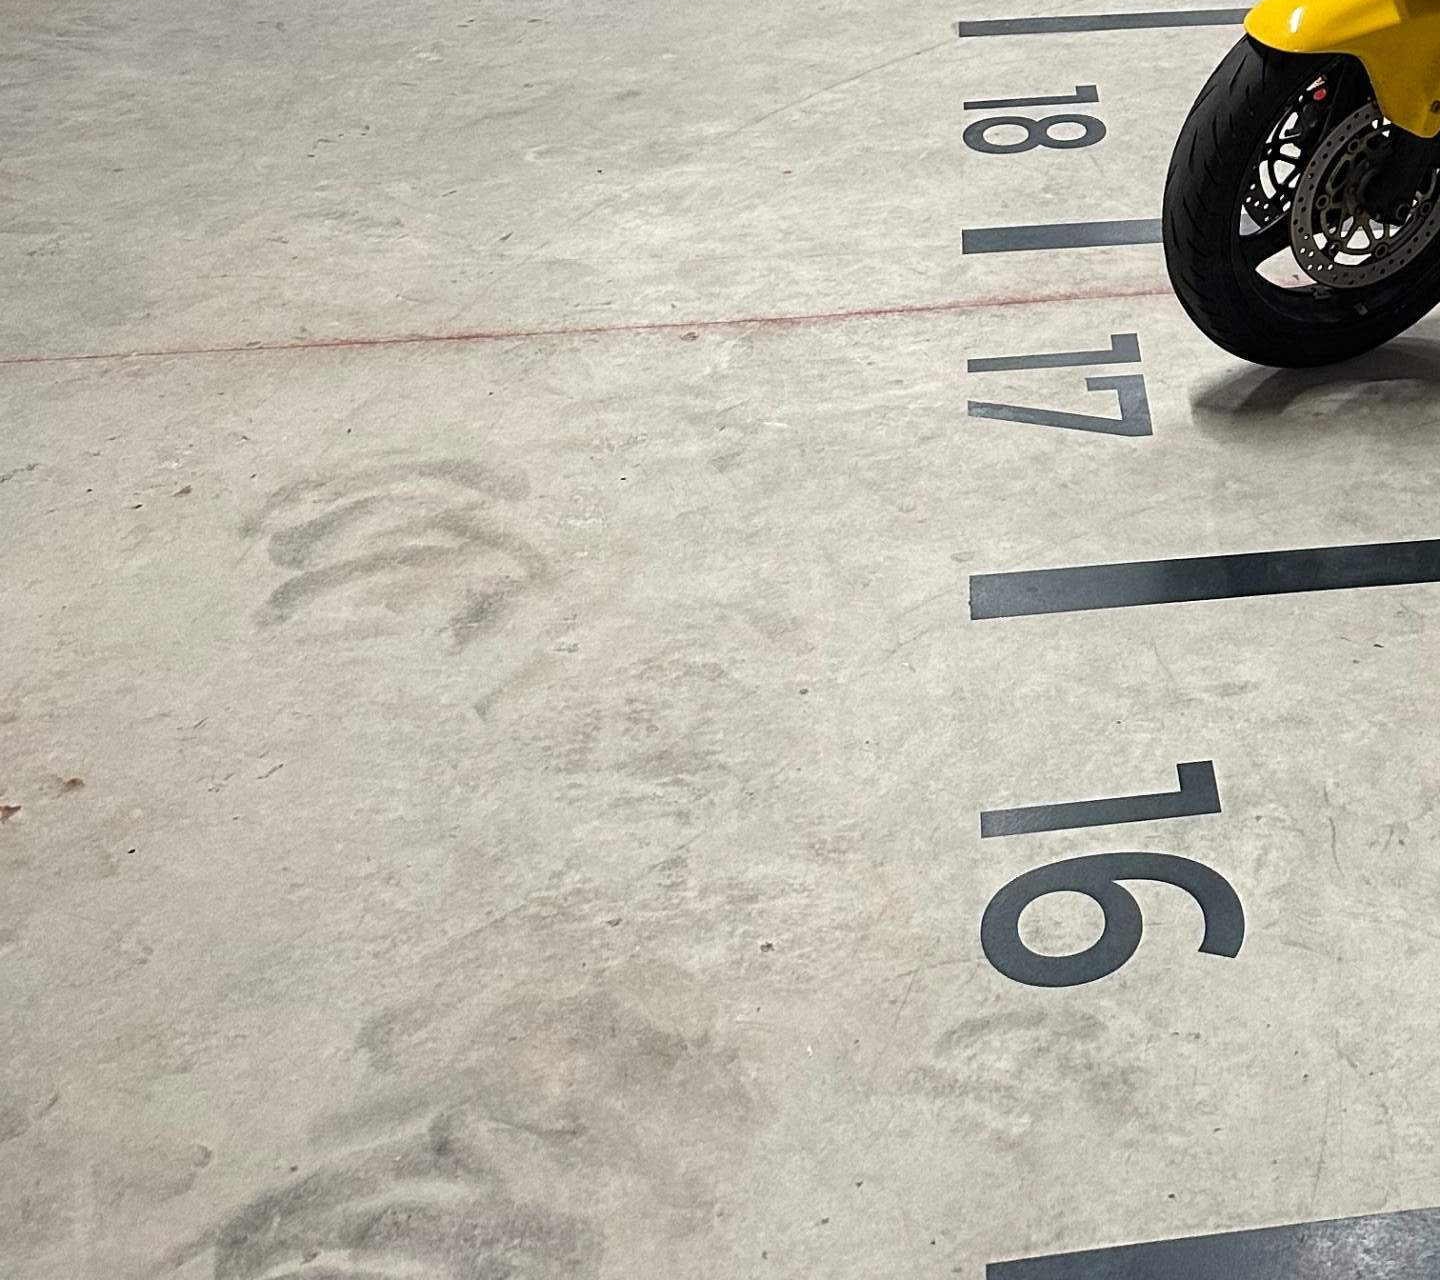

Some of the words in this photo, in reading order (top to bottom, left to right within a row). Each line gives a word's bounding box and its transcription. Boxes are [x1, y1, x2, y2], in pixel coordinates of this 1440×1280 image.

[962, 85, 1107, 155] 18
[967, 333, 1154, 437] 17
[980, 760, 1246, 989] 16
